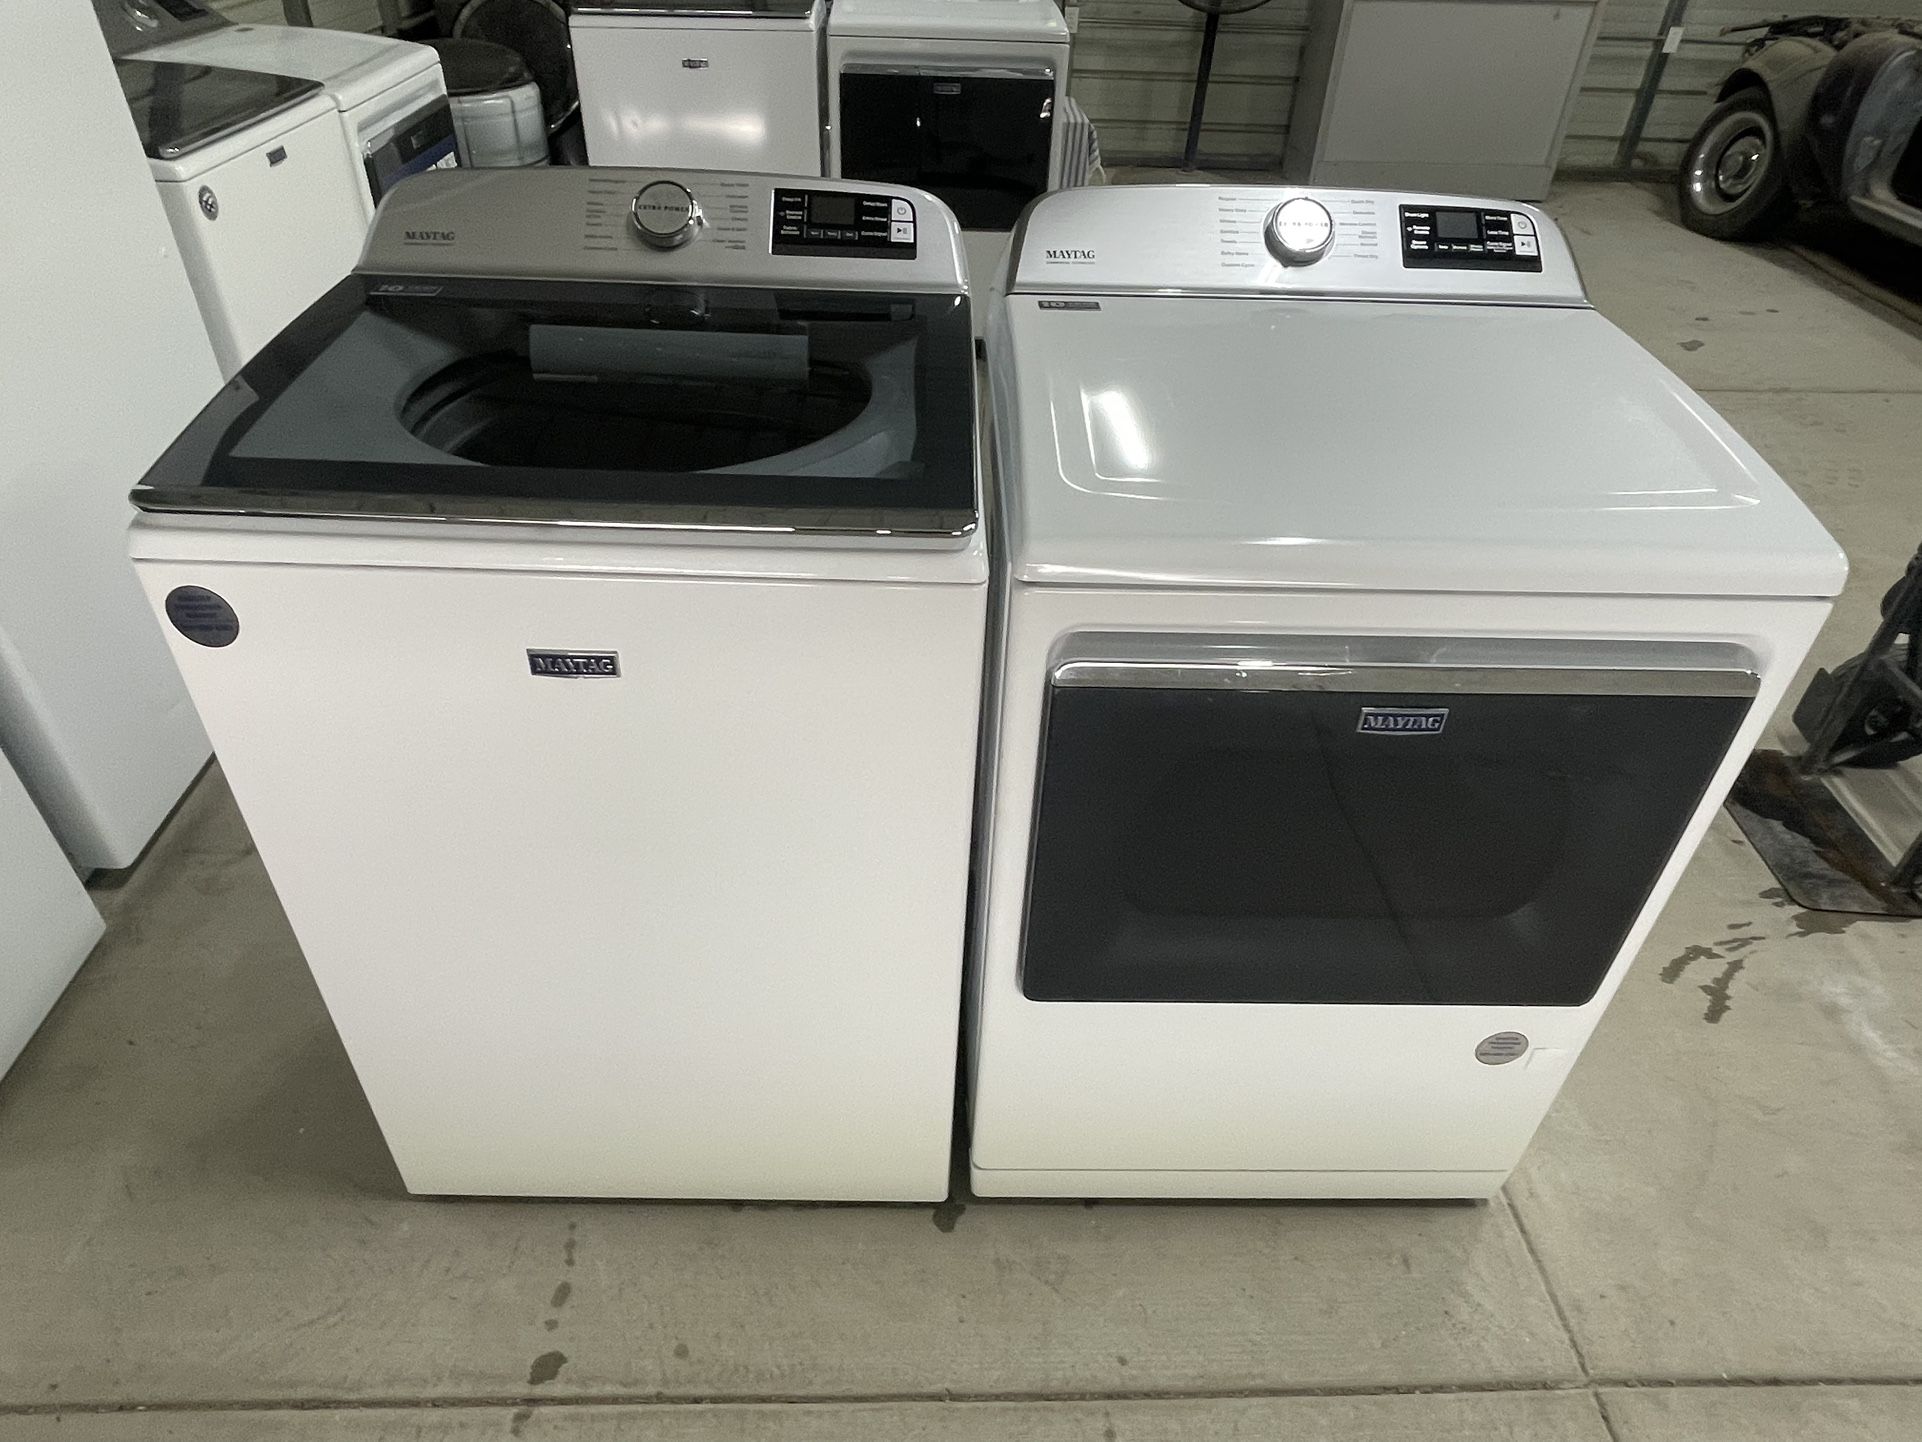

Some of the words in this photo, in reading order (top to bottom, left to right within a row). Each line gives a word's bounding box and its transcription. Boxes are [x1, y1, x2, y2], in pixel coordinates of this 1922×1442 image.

[404, 231, 456, 241] MAYTAG
[1045, 249, 1096, 259] MAYTAG
[532, 657, 614, 673] MAYTAG
[1363, 715, 1442, 729] MAYTAG
